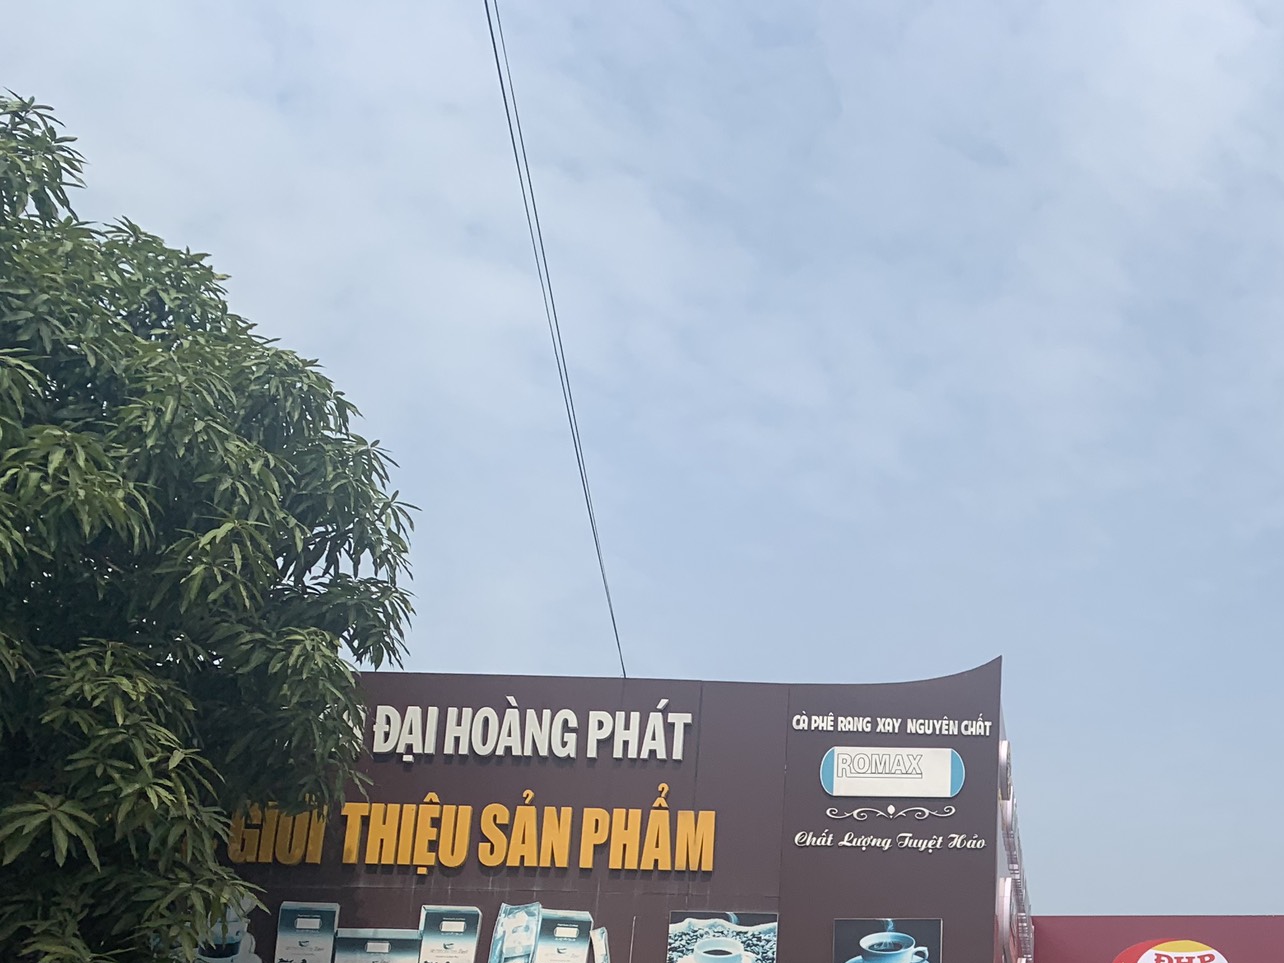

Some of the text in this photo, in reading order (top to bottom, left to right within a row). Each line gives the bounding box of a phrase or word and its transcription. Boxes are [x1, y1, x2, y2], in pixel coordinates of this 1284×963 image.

[373, 704, 438, 762] ĐẠI
[444, 696, 578, 760] HOÀNG
[586, 699, 692, 761] PHÁT
[792, 711, 992, 736] CÀ PHÊ RANG XAY NGUYÊN CHẤT
[837, 753, 923, 779] ROMAX
[341, 792, 473, 875] THIỆU
[478, 789, 572, 868] SẢN
[579, 783, 716, 871] PHẨM
[794, 829, 986, 853] Chất Lượng Tuyệt Hảo
